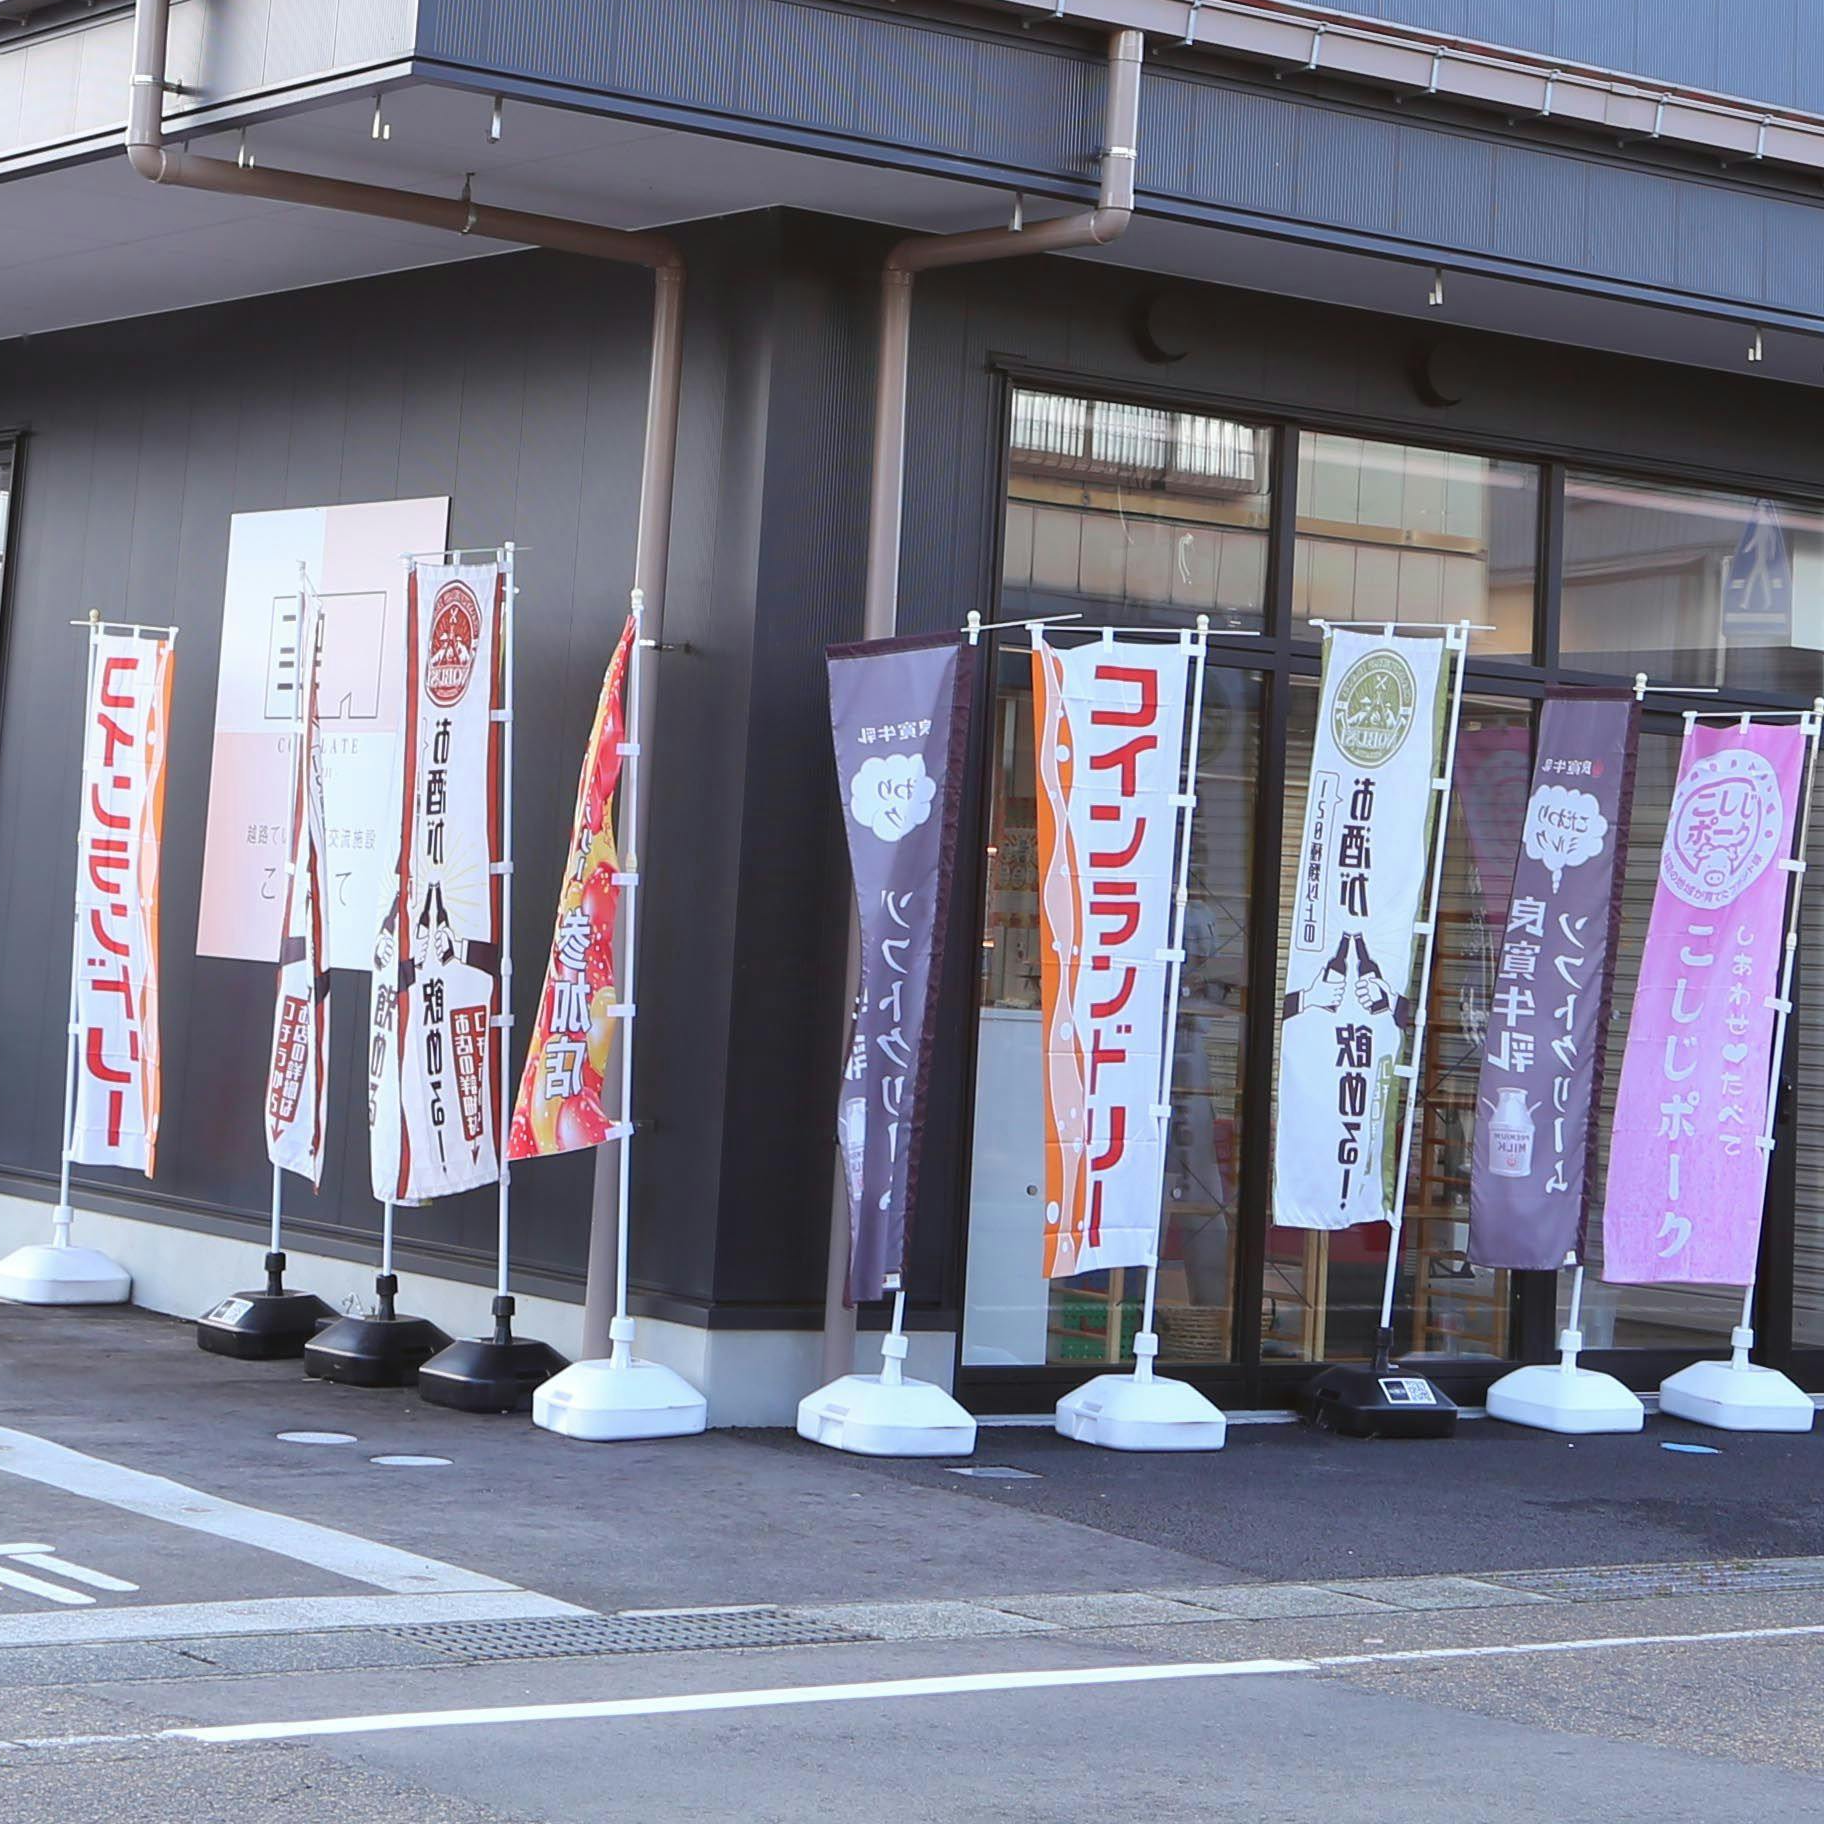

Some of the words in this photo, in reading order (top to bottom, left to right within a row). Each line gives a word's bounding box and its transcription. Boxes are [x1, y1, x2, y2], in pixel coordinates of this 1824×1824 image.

[1684, 817, 1751, 847] ポーク
[1692, 790, 1758, 819] こしじ
[1087, 663, 1159, 1248] コインランドリー
[1656, 924, 1714, 1258] こしじポーク
